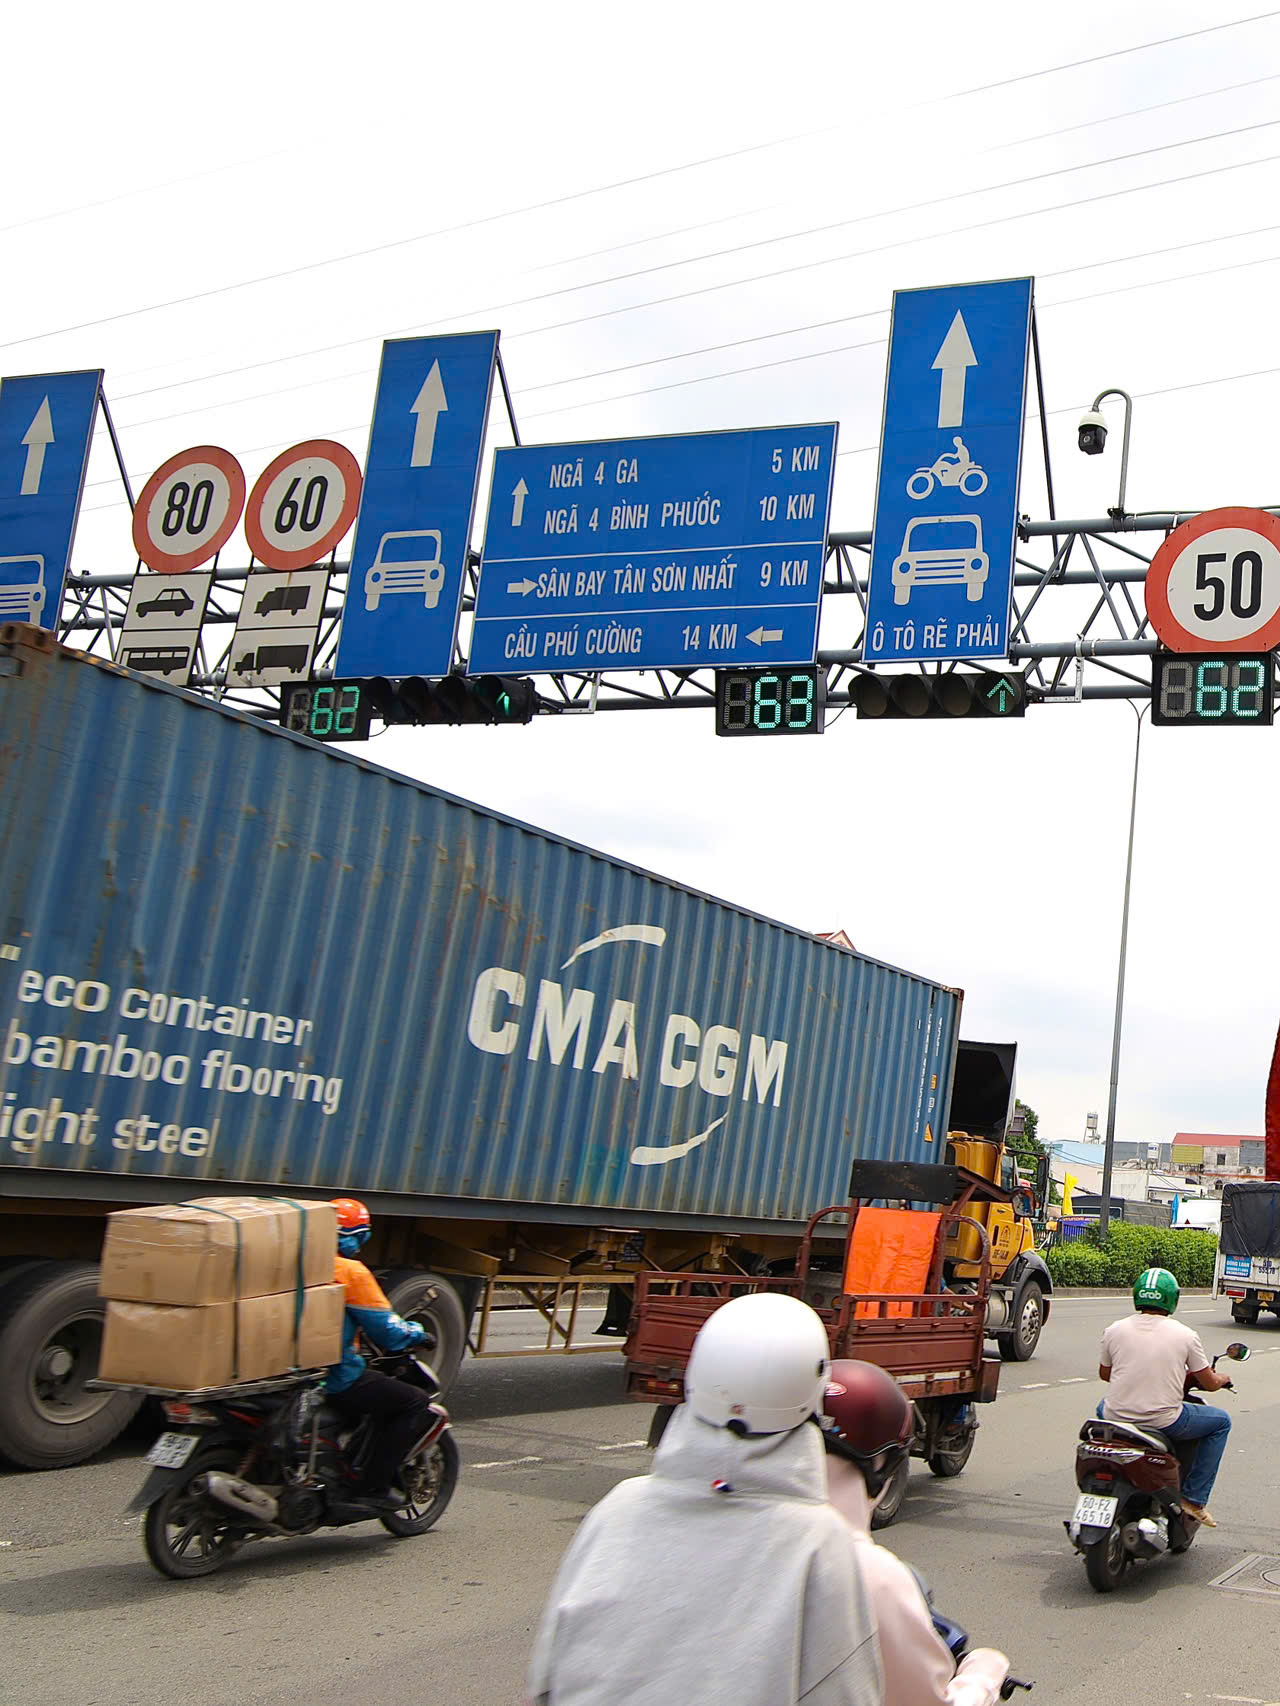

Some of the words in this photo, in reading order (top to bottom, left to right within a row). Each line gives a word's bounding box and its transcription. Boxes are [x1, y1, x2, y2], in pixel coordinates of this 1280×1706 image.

[549, 458, 583, 488] NGÃ
[594, 461, 605, 485] 4
[616, 458, 639, 483] GA
[771, 448, 782, 473] 5
[791, 446, 820, 472] KM
[162, 479, 215, 537] 80
[274, 475, 329, 533] 60
[544, 505, 578, 534] NGÃ
[588, 508, 599, 531] 4
[610, 499, 649, 530] BÌNH
[660, 491, 721, 527] PHƯỚC
[759, 495, 778, 521] 10
[786, 494, 815, 520] KM
[536, 567, 570, 598] SÂN
[575, 570, 606, 595] BAY
[613, 564, 646, 594] TÂN
[651, 564, 689, 593] SƠN
[691, 554, 737, 591] NHẤT
[760, 561, 771, 588] 9
[780, 560, 809, 586] KM
[1193, 550, 1264, 622] 50
[504, 622, 536, 658] CẦU
[543, 624, 579, 656] PHÚ
[585, 620, 643, 655] CƯỜNG
[682, 625, 700, 651] 14
[708, 623, 737, 650] KM
[872, 621, 885, 651] Ô
[893, 620, 915, 650] TÔ
[923, 617, 948, 649] RẼ
[956, 614, 999, 647] PHẢI
[310, 685, 360, 735] 62
[754, 675, 814, 729] 63
[1195, 660, 1266, 717] 62
[17, 969, 111, 1013] eco
[119, 986, 313, 1047] container
[468, 967, 639, 1080] CMA
[659, 1013, 788, 1109] CGM
[3, 1018, 191, 1086] bamboo
[200, 1048, 344, 1116] flooring
[0, 1091, 100, 1154] ight
[111, 1113, 220, 1158] steel
[1139, 1289, 1162, 1300] Grab
